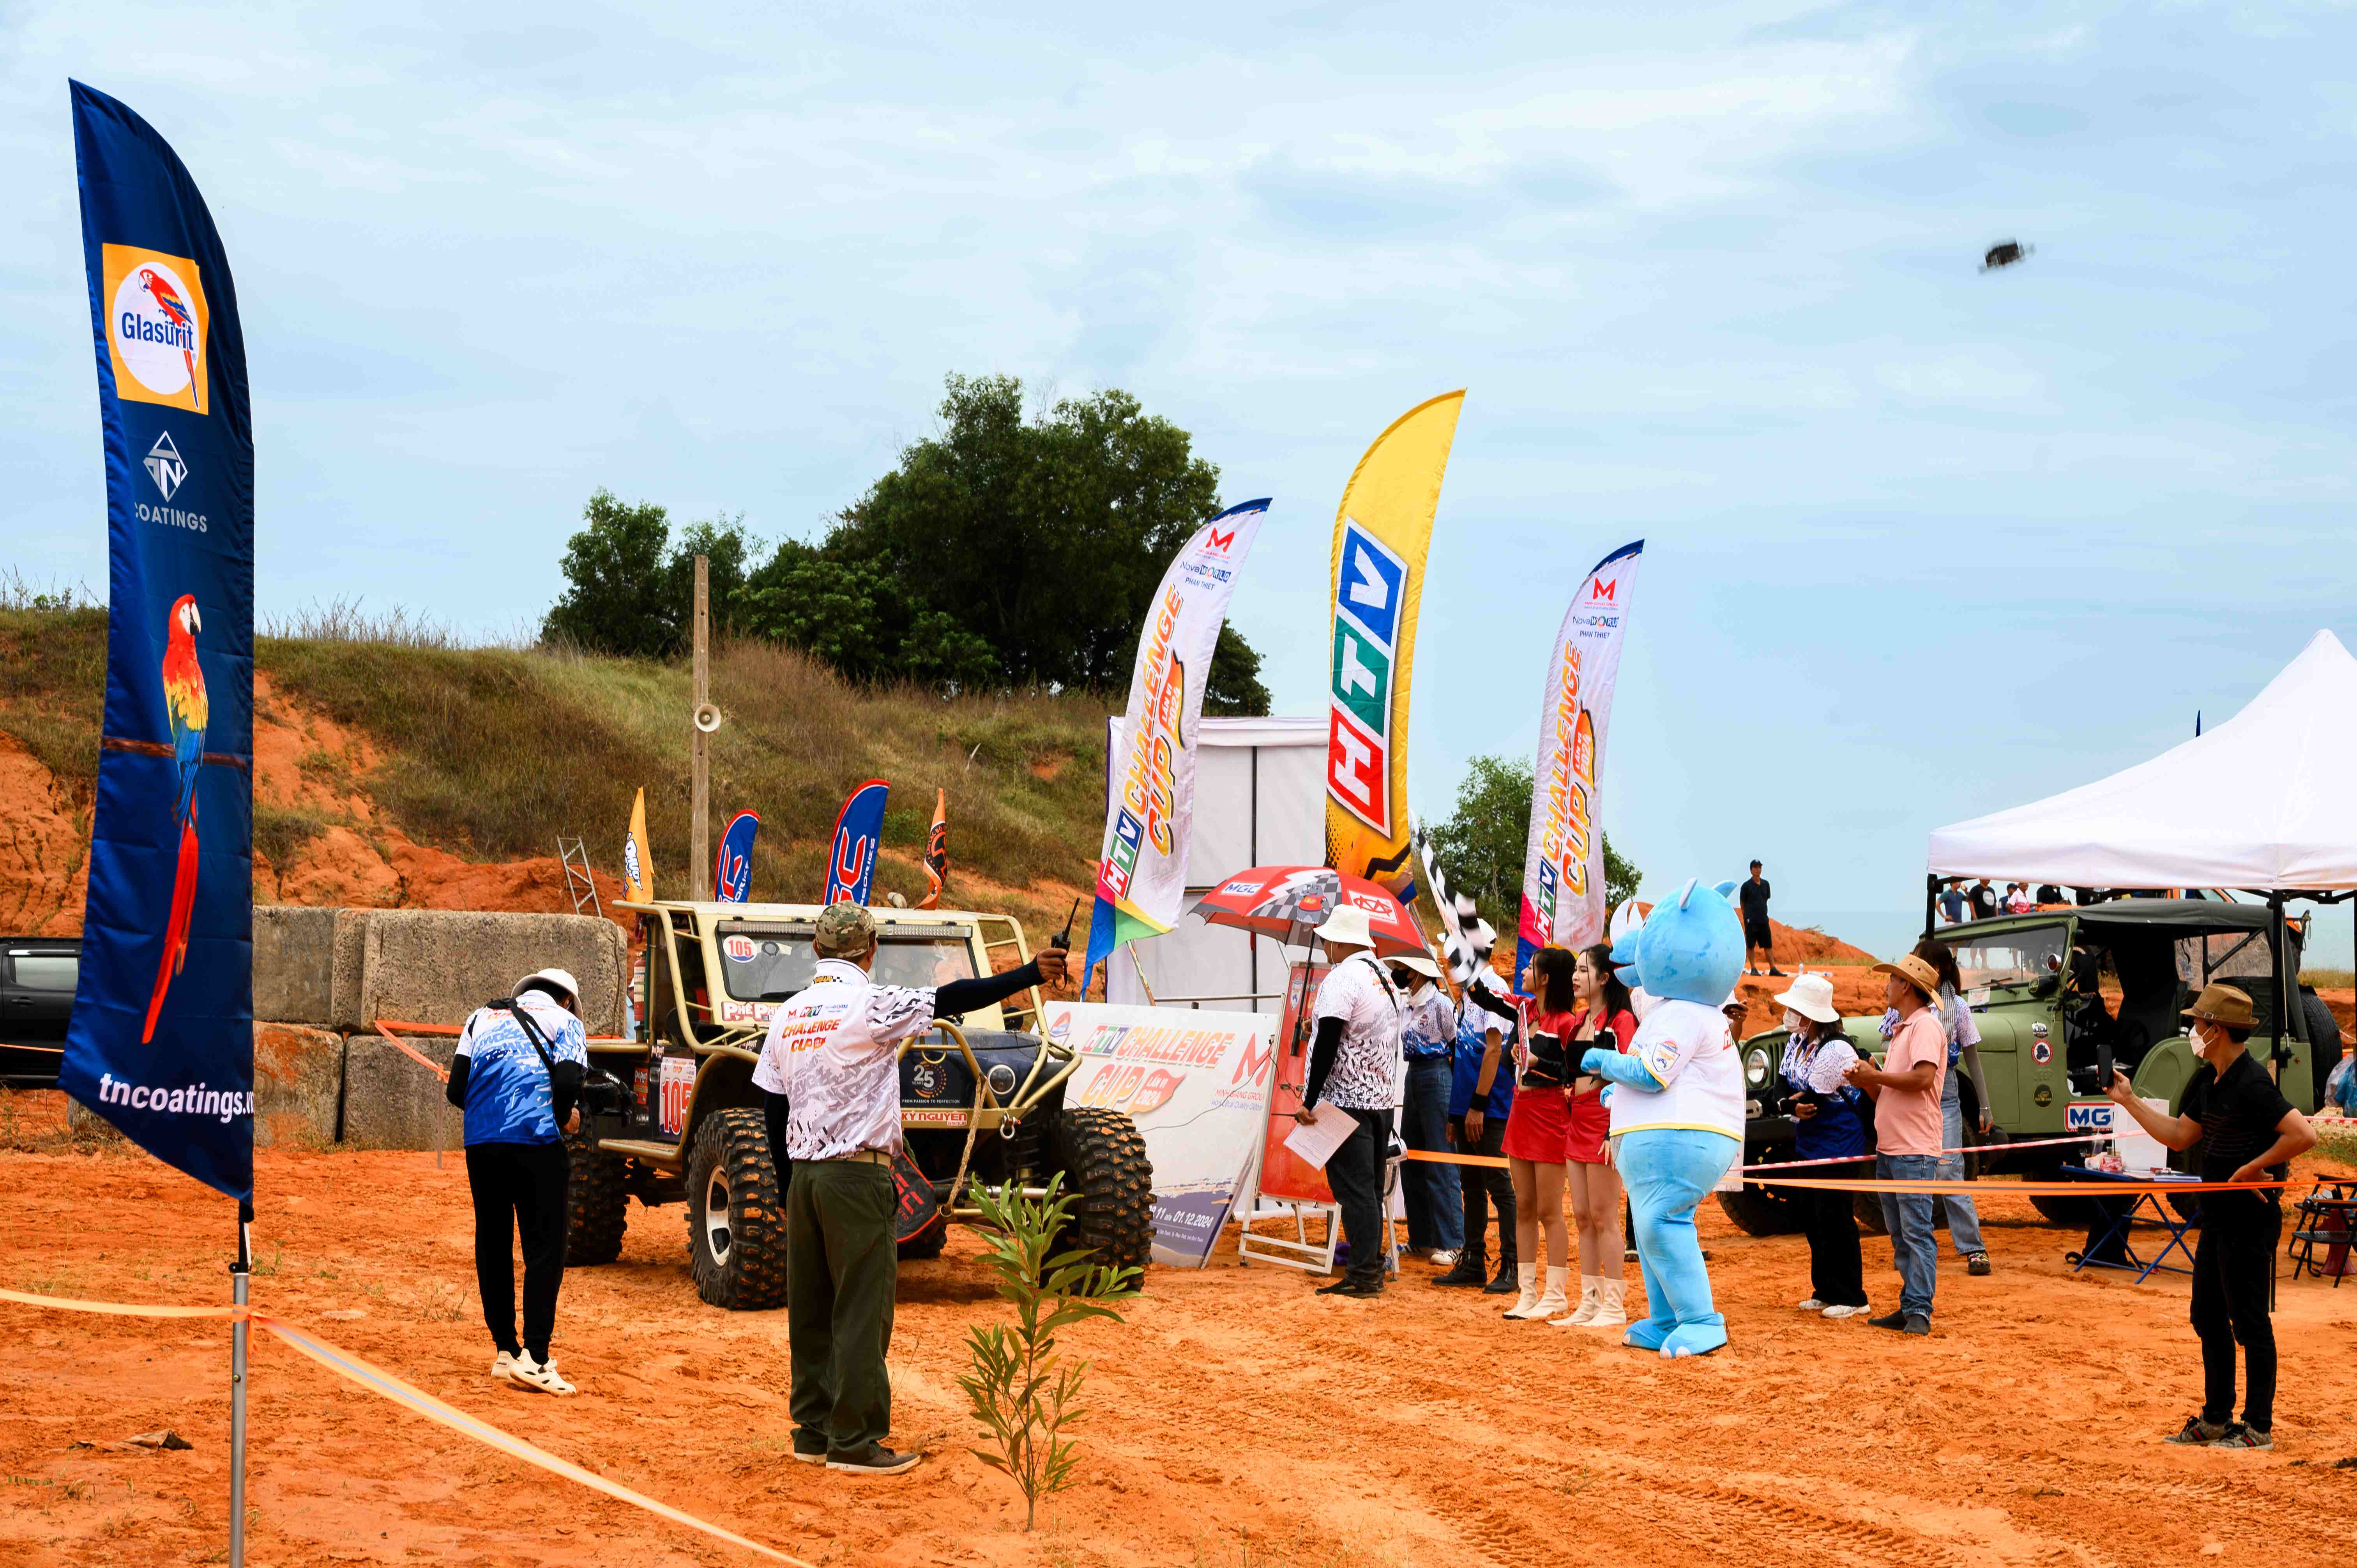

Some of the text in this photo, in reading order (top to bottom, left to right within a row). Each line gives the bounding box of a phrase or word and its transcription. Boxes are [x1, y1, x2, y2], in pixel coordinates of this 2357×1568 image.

[122, 312, 194, 351] Glasurit
[1332, 538, 1392, 812] HTV
[1104, 584, 1183, 895] HTV CHALLENGE
[1148, 736, 1173, 856] CUP
[1535, 640, 1581, 941] HTV CHALLENGE
[1563, 782, 1590, 896] CUP
[1225, 884, 1262, 893] MGC
[729, 940, 751, 956] 105
[1082, 1026, 1235, 1067] HTV CHALLENGE
[605, 1072, 620, 1085] RONIN
[914, 1065, 934, 1088] 25
[1080, 1064, 1146, 1108] CUP
[661, 1079, 693, 1135] 105
[1136, 1089, 1161, 1105] 2024
[2070, 1109, 2114, 1125] MG
[1173, 1211, 1214, 1228] 01.12.2024
